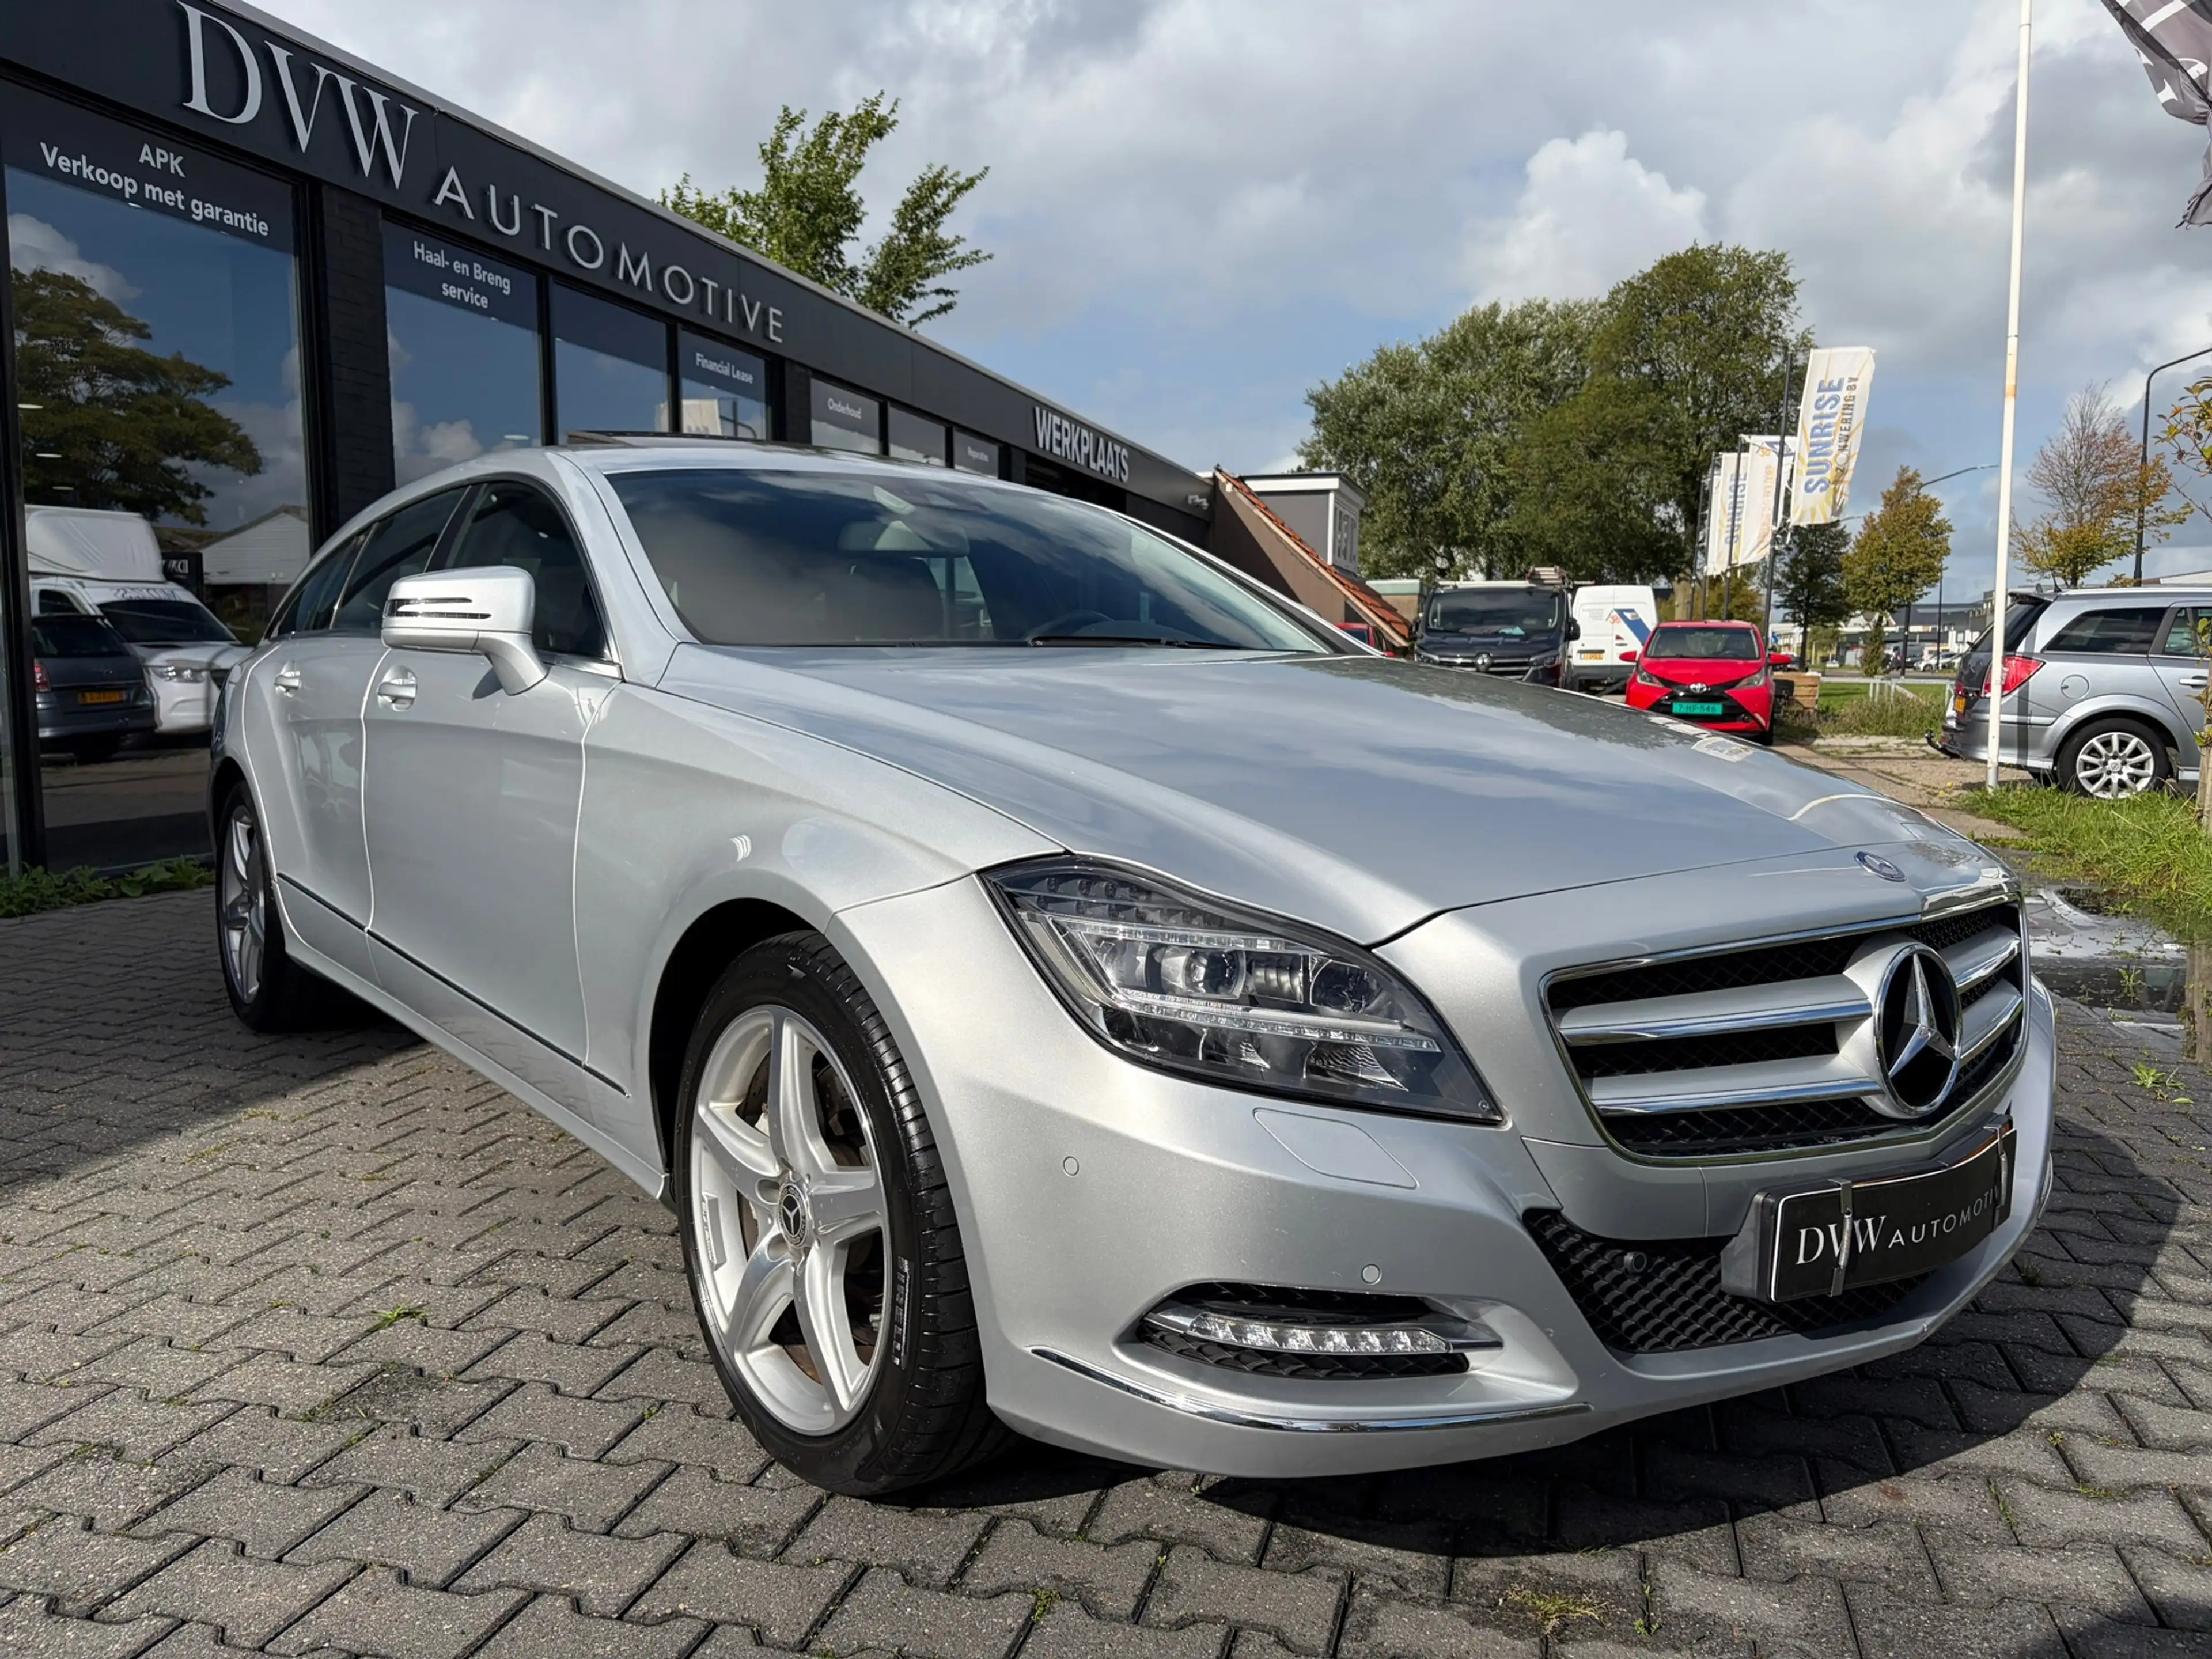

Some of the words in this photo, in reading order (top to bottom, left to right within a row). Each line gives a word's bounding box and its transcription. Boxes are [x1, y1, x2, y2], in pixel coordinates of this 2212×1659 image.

[139, 143, 185, 178] APK
[178, 1, 419, 190] DVW
[433, 166, 783, 344] AUTOMOTIVE
[40, 142, 138, 198] Verkoop
[145, 179, 185, 211] met
[191, 198, 269, 237] garantie
[414, 241, 450, 268] Haal-
[453, 259, 470, 277] en
[474, 264, 511, 295] Breng
[442, 283, 488, 309] service
[695, 352, 730, 377] Financial
[732, 364, 753, 384] Lease
[1846, 377, 1859, 392] BV
[828, 397, 862, 419] Onderhoud
[1035, 406, 1129, 483] WERKPLAATS
[1804, 377, 1844, 494] SUNRISE
[1795, 1215, 1887, 1265] DVW
[1888, 1185, 1999, 1249] AUTOMOTIV
